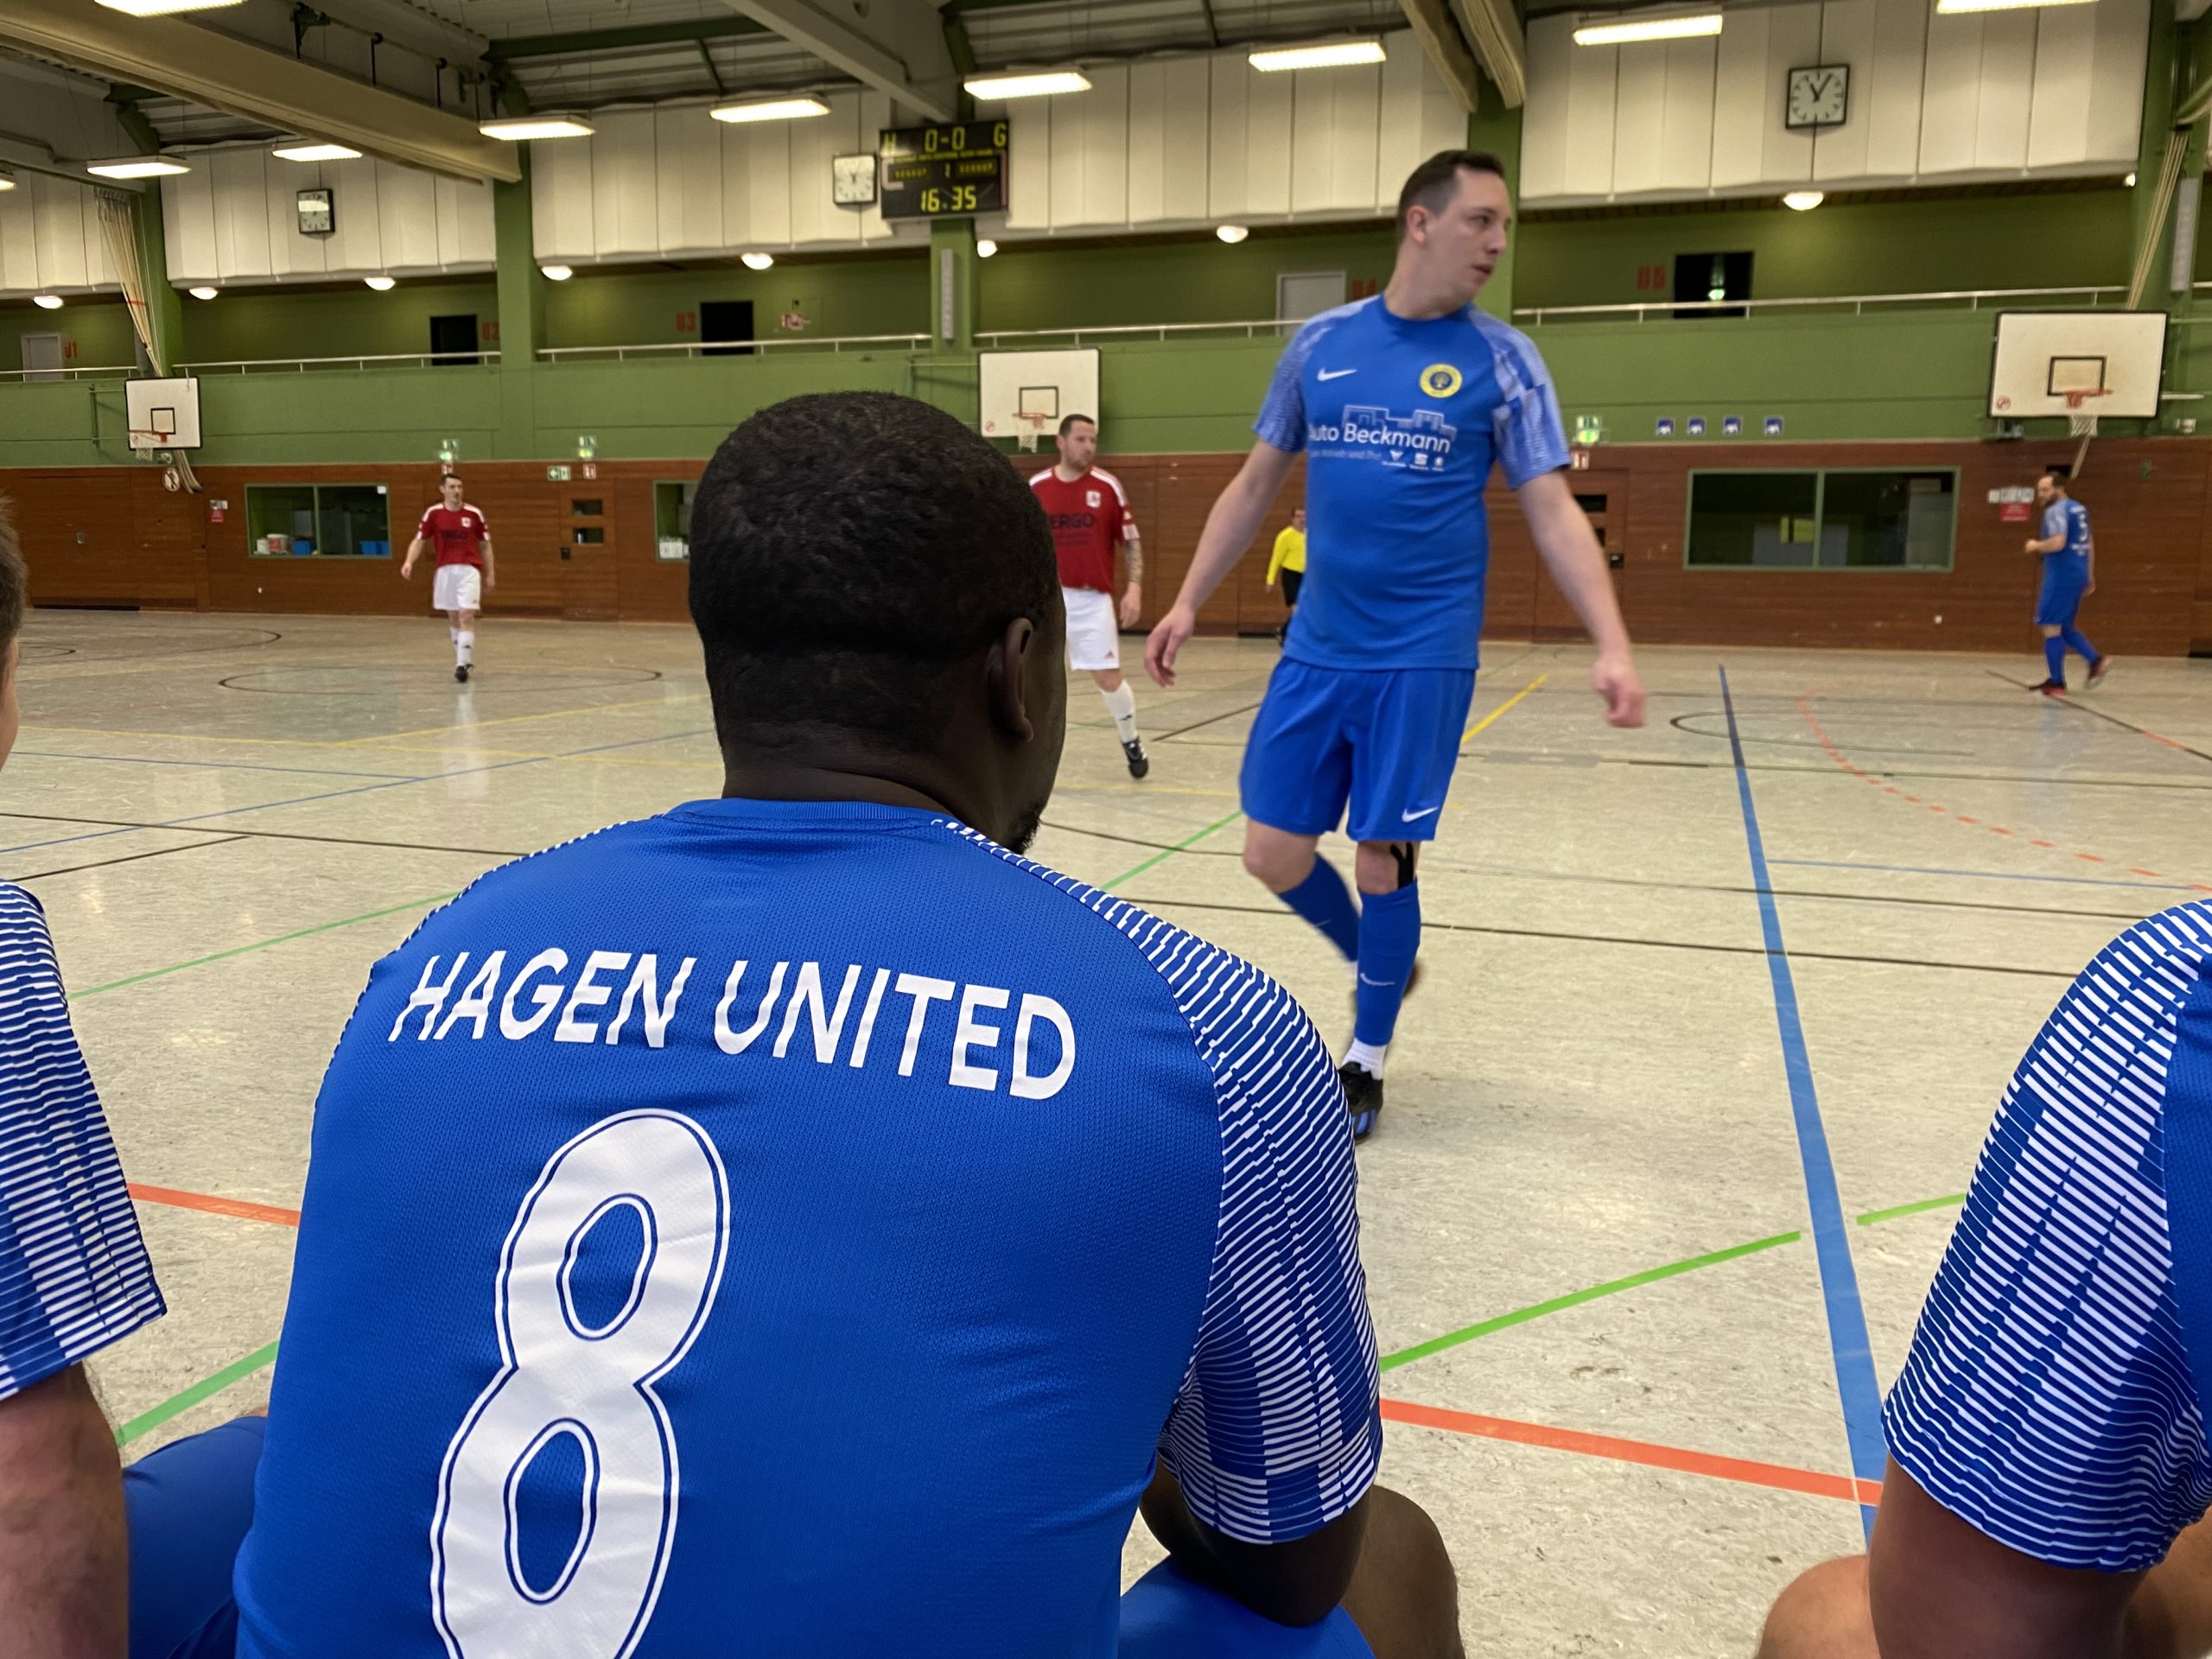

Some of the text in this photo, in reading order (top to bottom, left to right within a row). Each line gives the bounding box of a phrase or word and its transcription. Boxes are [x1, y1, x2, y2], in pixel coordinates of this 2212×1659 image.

[994, 123, 1007, 148] G
[1343, 423, 1451, 454] Beckmann
[388, 947, 1076, 1100] HAGEN UNITED
[430, 1108, 731, 1659] 8
